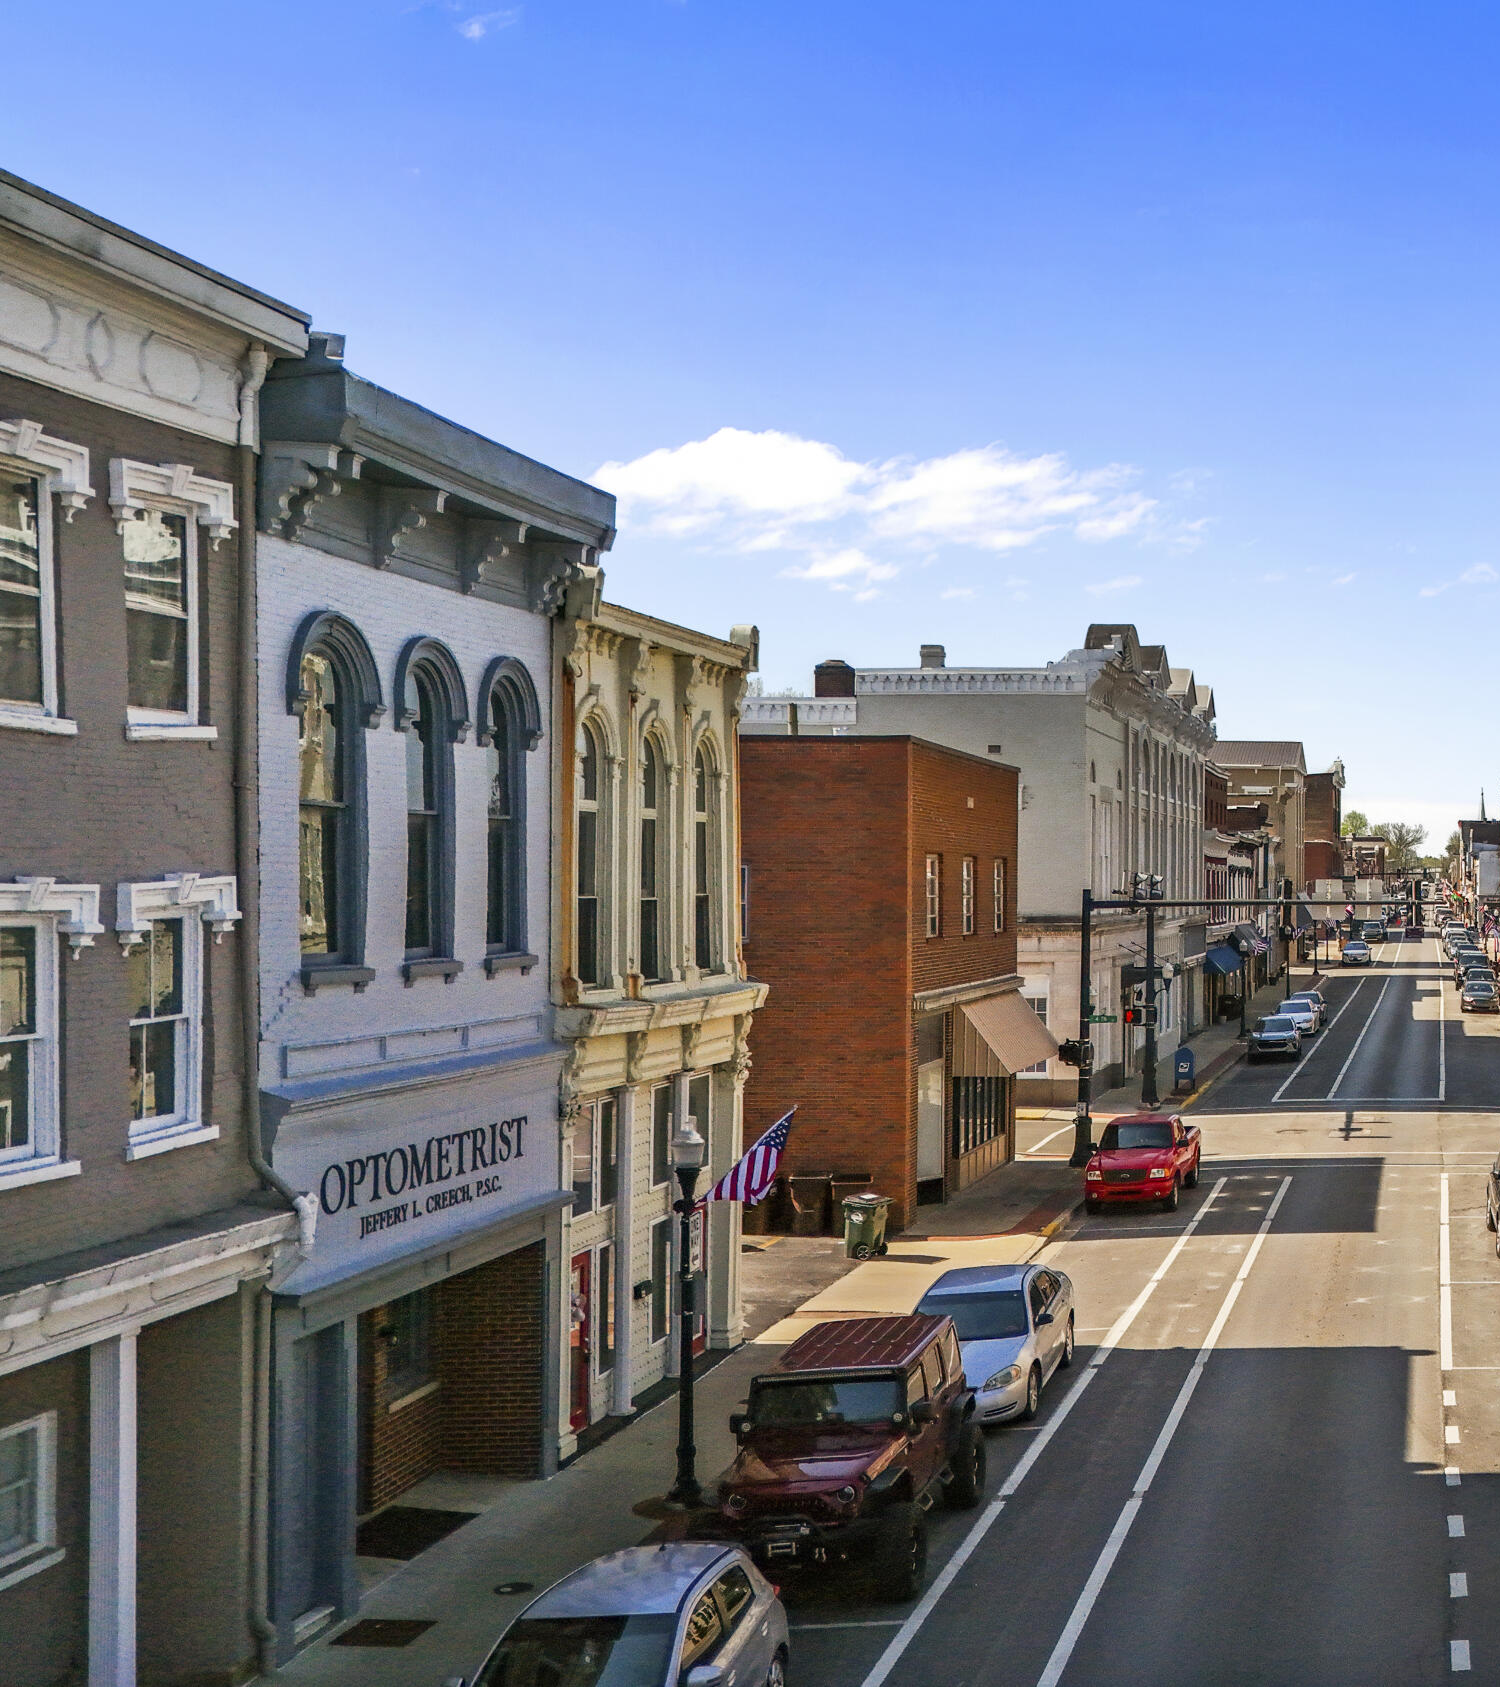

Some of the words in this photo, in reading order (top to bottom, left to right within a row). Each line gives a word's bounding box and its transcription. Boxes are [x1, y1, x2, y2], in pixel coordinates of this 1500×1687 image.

[320, 1115, 528, 1215] OPTOMETRIST
[359, 1203, 408, 1239] JEFFERY
[412, 1201, 422, 1219] L.
[426, 1184, 472, 1214] CREECH,
[476, 1175, 502, 1198] P.S.C.
